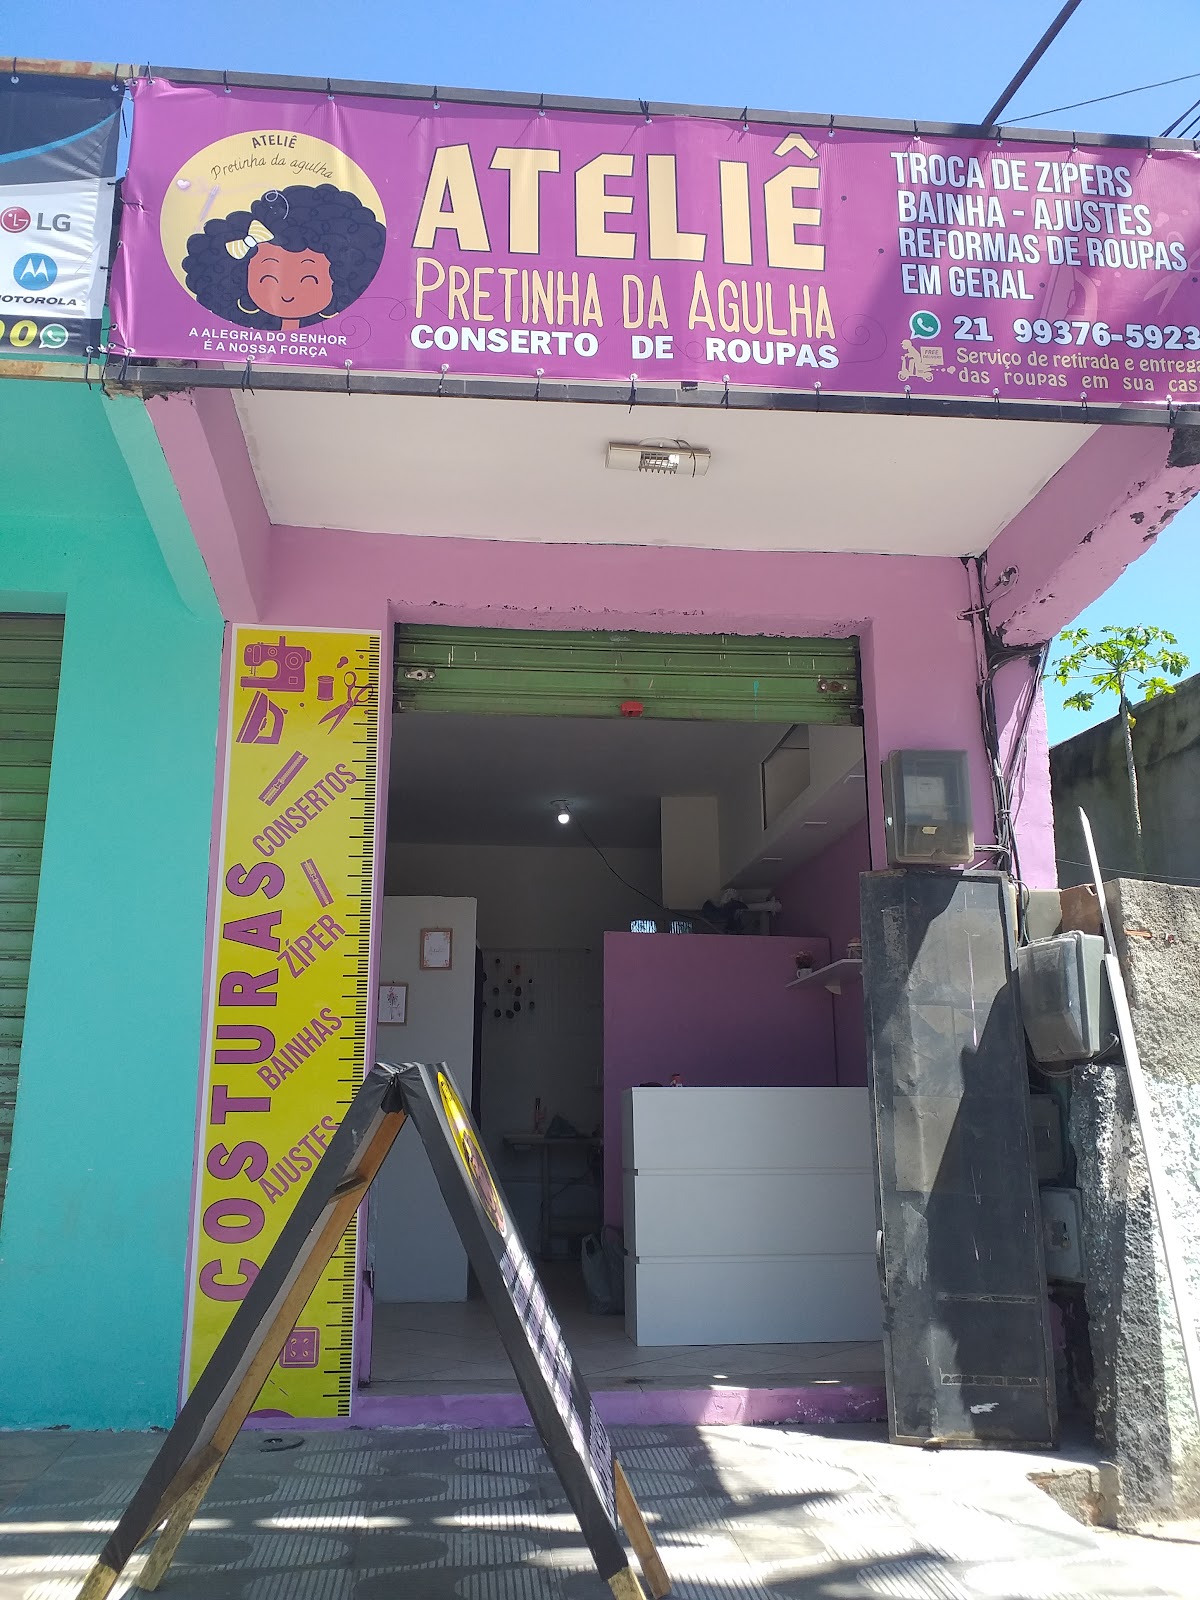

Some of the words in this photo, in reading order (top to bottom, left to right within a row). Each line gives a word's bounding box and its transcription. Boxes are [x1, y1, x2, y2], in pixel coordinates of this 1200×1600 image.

[251, 134, 298, 149] ATELIÊ
[210, 153, 267, 180] Pretinha
[270, 153, 287, 166] da
[289, 159, 334, 179] agulha
[890, 152, 985, 190] TROCA
[991, 158, 1029, 193] DE
[1034, 161, 1133, 198] ZIPERS
[411, 132, 827, 272] ATELIÊ
[897, 190, 1006, 228] BAINHA
[1034, 198, 1153, 237] AJUSTES
[36, 212, 71, 232] LG
[899, 227, 1041, 266] REFORMAS
[1046, 235, 1081, 266] DE
[1087, 237, 1189, 271] ROUPAS
[0, 295, 77, 305] OTOROLA
[901, 263, 942, 296] EM
[948, 267, 1035, 300] GERAL
[188, 327, 199, 337] A
[201, 328, 263, 342] ALEGRIA
[266, 332, 286, 342] DO
[289, 333, 347, 346] SENHOR
[203, 338, 213, 350] É
[215, 341, 225, 351] A
[229, 342, 277, 354] NOSSA
[280, 345, 328, 357] FORÇA
[411, 324, 599, 358] CONSERTO
[631, 334, 674, 360] DE
[705, 338, 840, 369] ROUPAS
[952, 315, 994, 341] 21
[1012, 318, 1200, 351] 99376-5923
[956, 347, 1022, 369] Serviço
[1027, 351, 1049, 367] de
[1053, 352, 1120, 370] retirada
[1124, 358, 1135, 371] e
[958, 366, 991, 384] das
[1004, 372, 1068, 387] roupas
[1081, 375, 1109, 389] em
[1122, 376, 1155, 391] sua
[1168, 379, 1200, 392] cas
[251, 763, 358, 858] CONSERTOS
[276, 914, 348, 979] ZÍPER
[256, 1007, 344, 1091] BAINHAS
[198, 861, 286, 1302] COSTURAS
